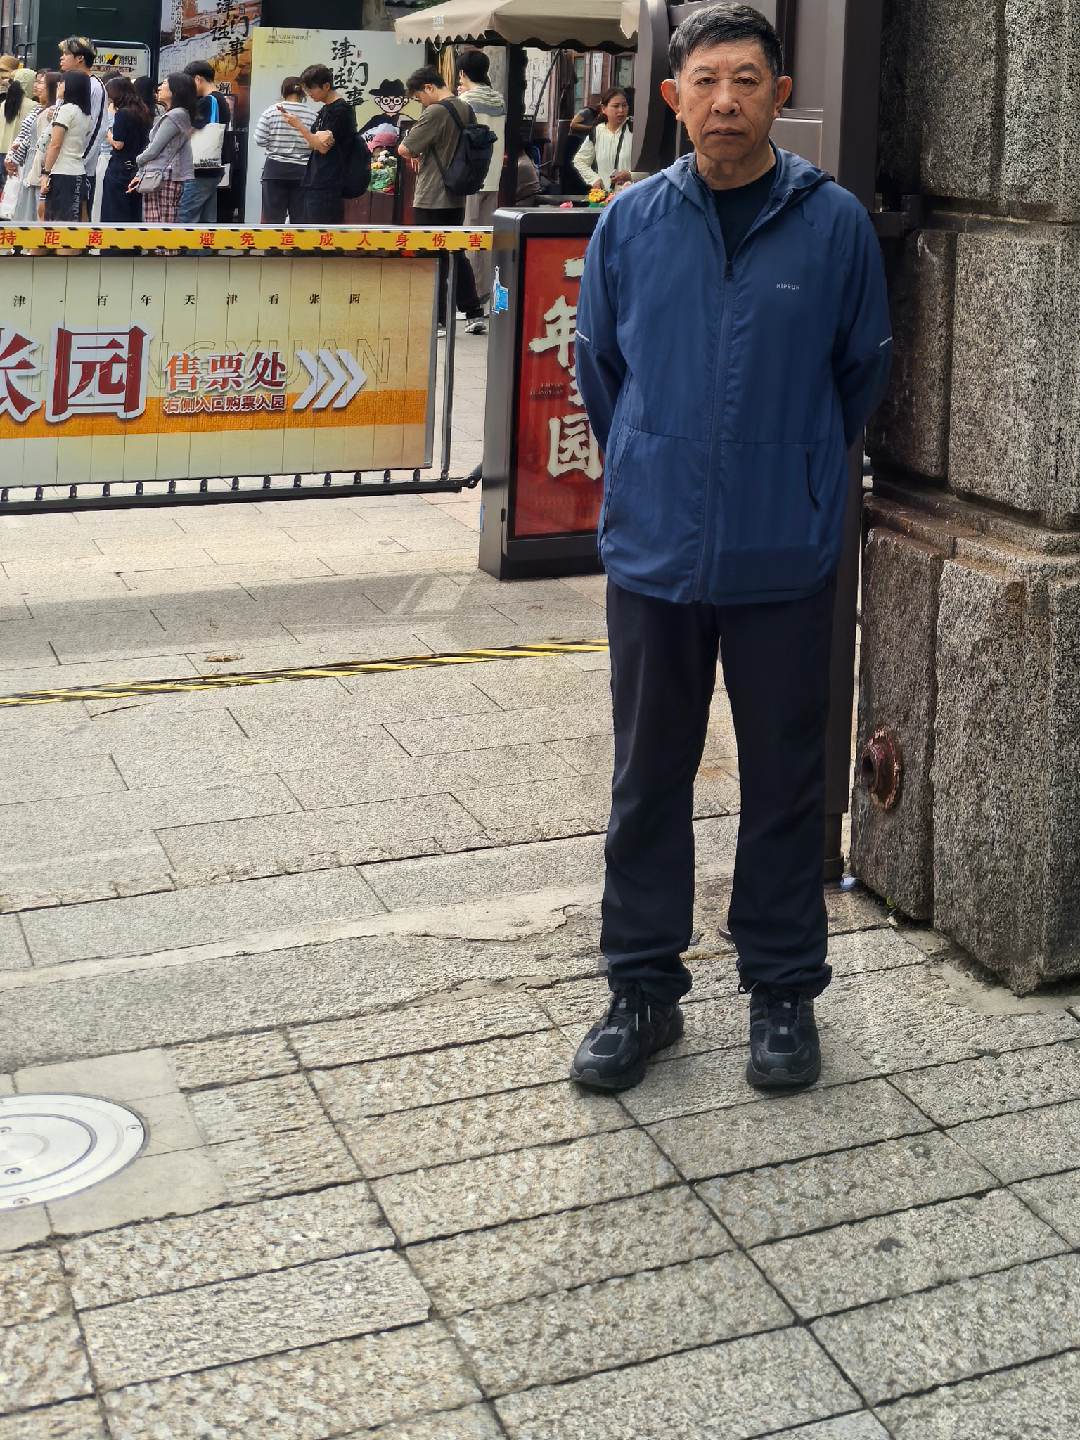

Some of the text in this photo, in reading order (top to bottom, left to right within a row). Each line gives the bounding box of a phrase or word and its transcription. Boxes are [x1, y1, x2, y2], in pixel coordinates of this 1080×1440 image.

[166, 351, 287, 393] 售票处
[163, 394, 287, 414] 右侧入口购票入园
